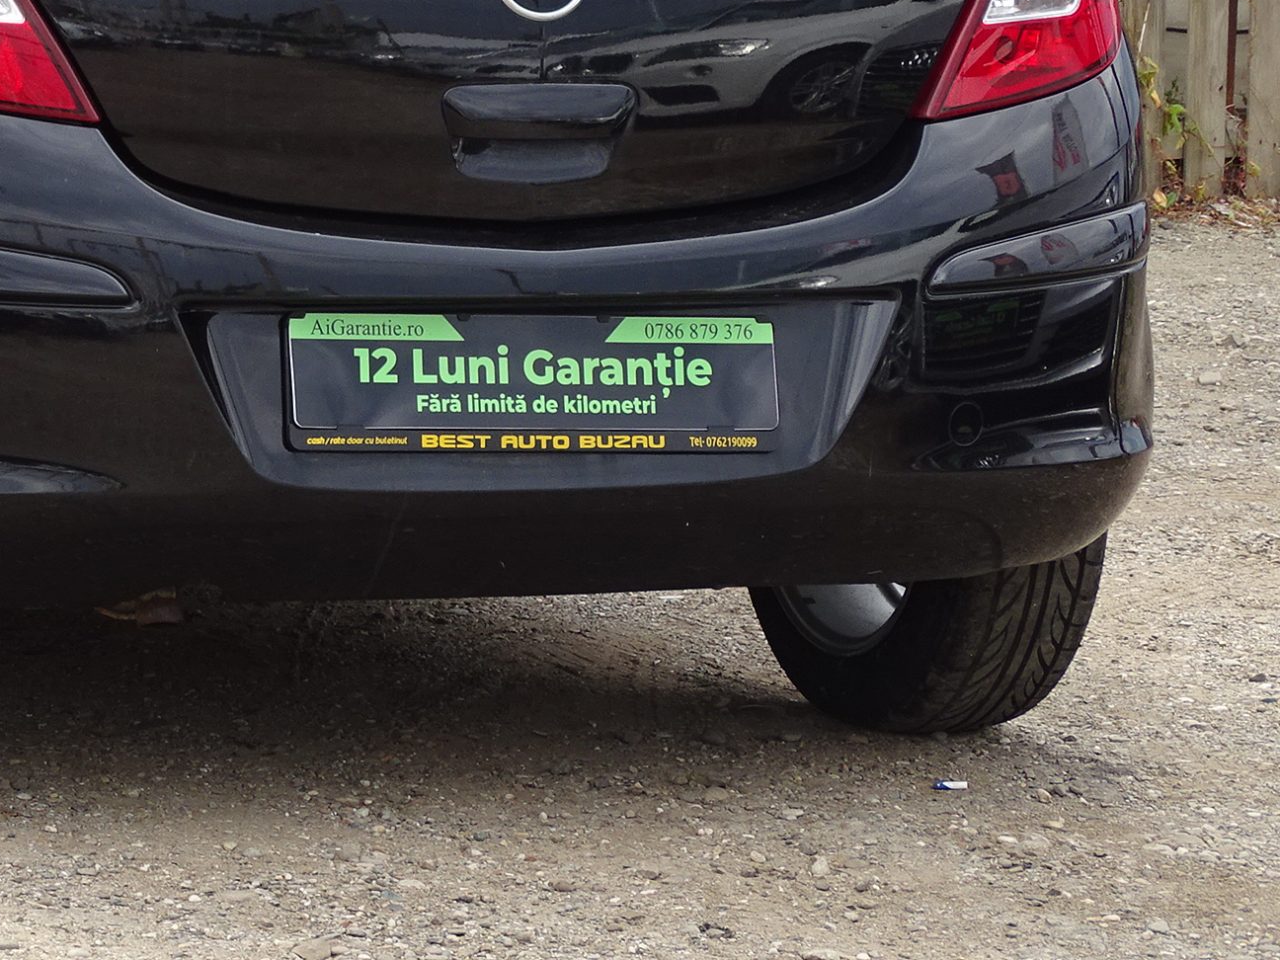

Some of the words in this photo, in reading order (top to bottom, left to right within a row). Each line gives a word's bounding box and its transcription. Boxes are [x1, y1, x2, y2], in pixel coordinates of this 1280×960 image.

[310, 318, 425, 338] AiGarantie.ro
[644, 322, 685, 340] 0786
[689, 323, 719, 341] 879
[723, 323, 754, 341] 376
[352, 347, 399, 384] 12
[412, 344, 510, 385] Luni
[522, 346, 714, 399] Garanție
[416, 394, 462, 413] Fără
[467, 393, 528, 414] limită
[532, 394, 559, 414] de
[563, 393, 657, 415] kilometri
[421, 434, 491, 449] BEST
[501, 434, 570, 449] AUTO
[579, 435, 665, 449] BUZAU
[706, 436, 758, 448] 0762190099
